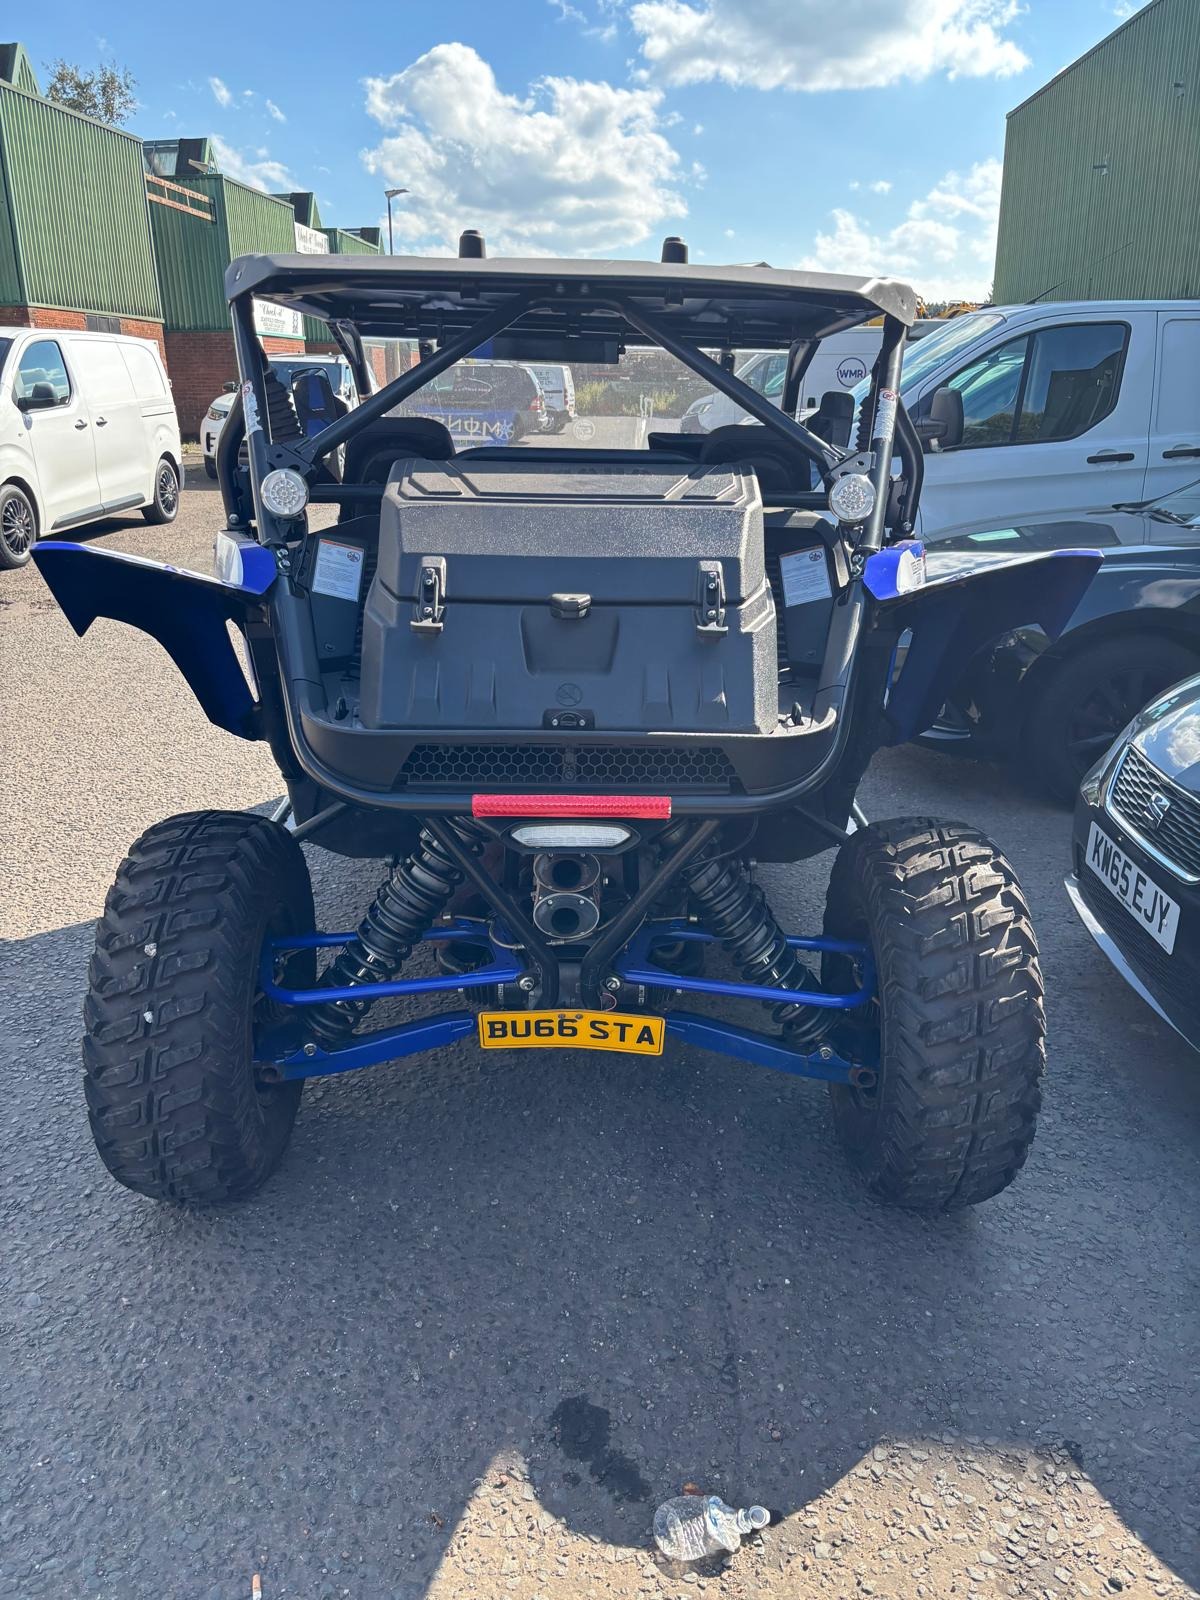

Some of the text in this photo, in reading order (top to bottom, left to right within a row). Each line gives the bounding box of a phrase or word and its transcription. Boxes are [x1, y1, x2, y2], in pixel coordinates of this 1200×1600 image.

[839, 369, 863, 378] WMR
[1092, 831, 1170, 934] KW65 EJY
[487, 1019, 655, 1046] BU66 STA
